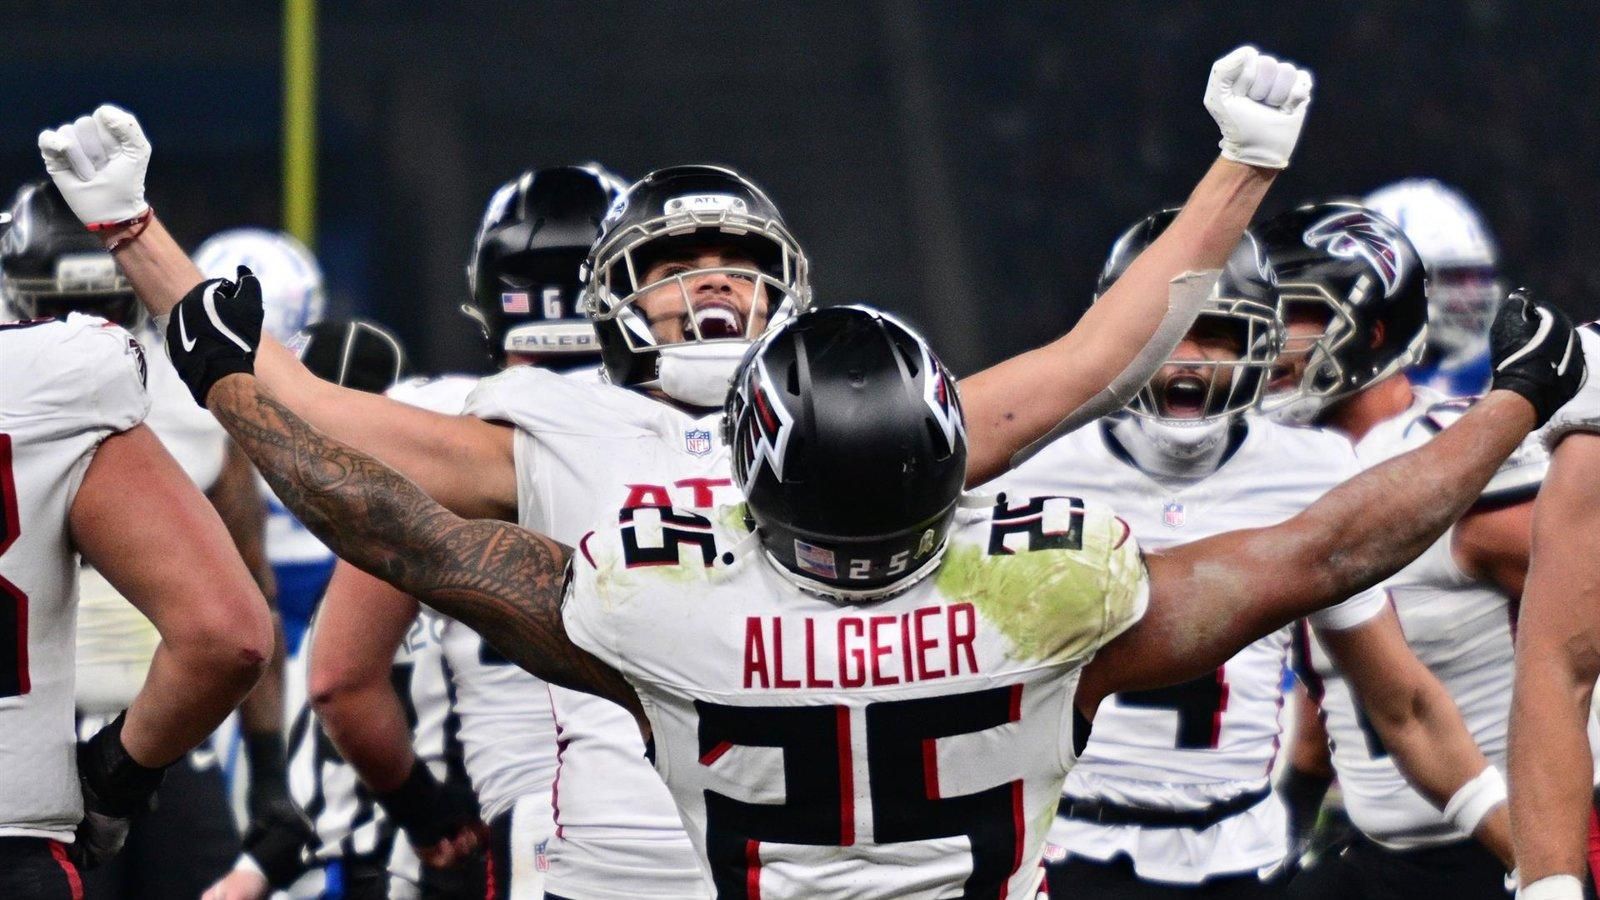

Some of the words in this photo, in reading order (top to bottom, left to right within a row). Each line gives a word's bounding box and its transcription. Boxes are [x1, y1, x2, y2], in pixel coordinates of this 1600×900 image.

[849, 550, 910, 580] 25
[743, 602, 979, 689] ALLGEIER
[694, 683, 1024, 900] 25
